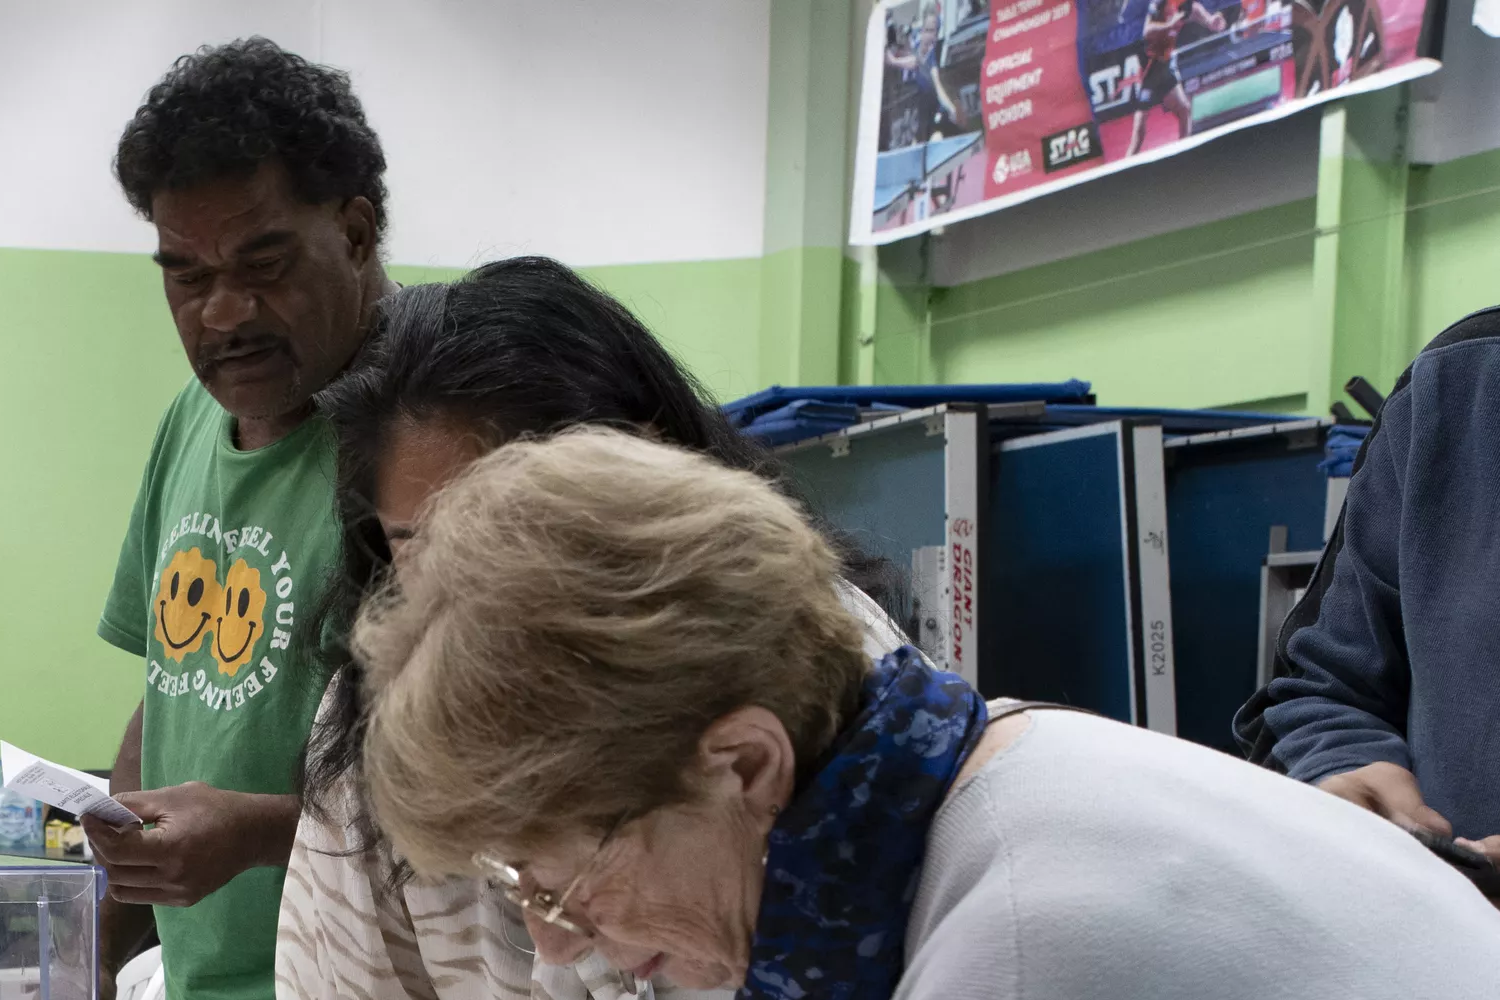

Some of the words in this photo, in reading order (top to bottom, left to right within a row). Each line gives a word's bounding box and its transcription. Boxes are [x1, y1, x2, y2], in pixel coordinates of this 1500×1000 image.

[986, 47, 1032, 77] OFFICIAL
[986, 67, 1043, 104] EQUIPMENT
[988, 98, 1032, 130] SPONSOR
[223, 526, 273, 556] FEEL
[270, 550, 295, 650] YOUR
[953, 542, 962, 664] DRAGON
[963, 548, 973, 631] GIANT
[1150, 620, 1165, 676] K2025
[147, 660, 190, 697] FEEL
[192, 656, 278, 711] FEELING
